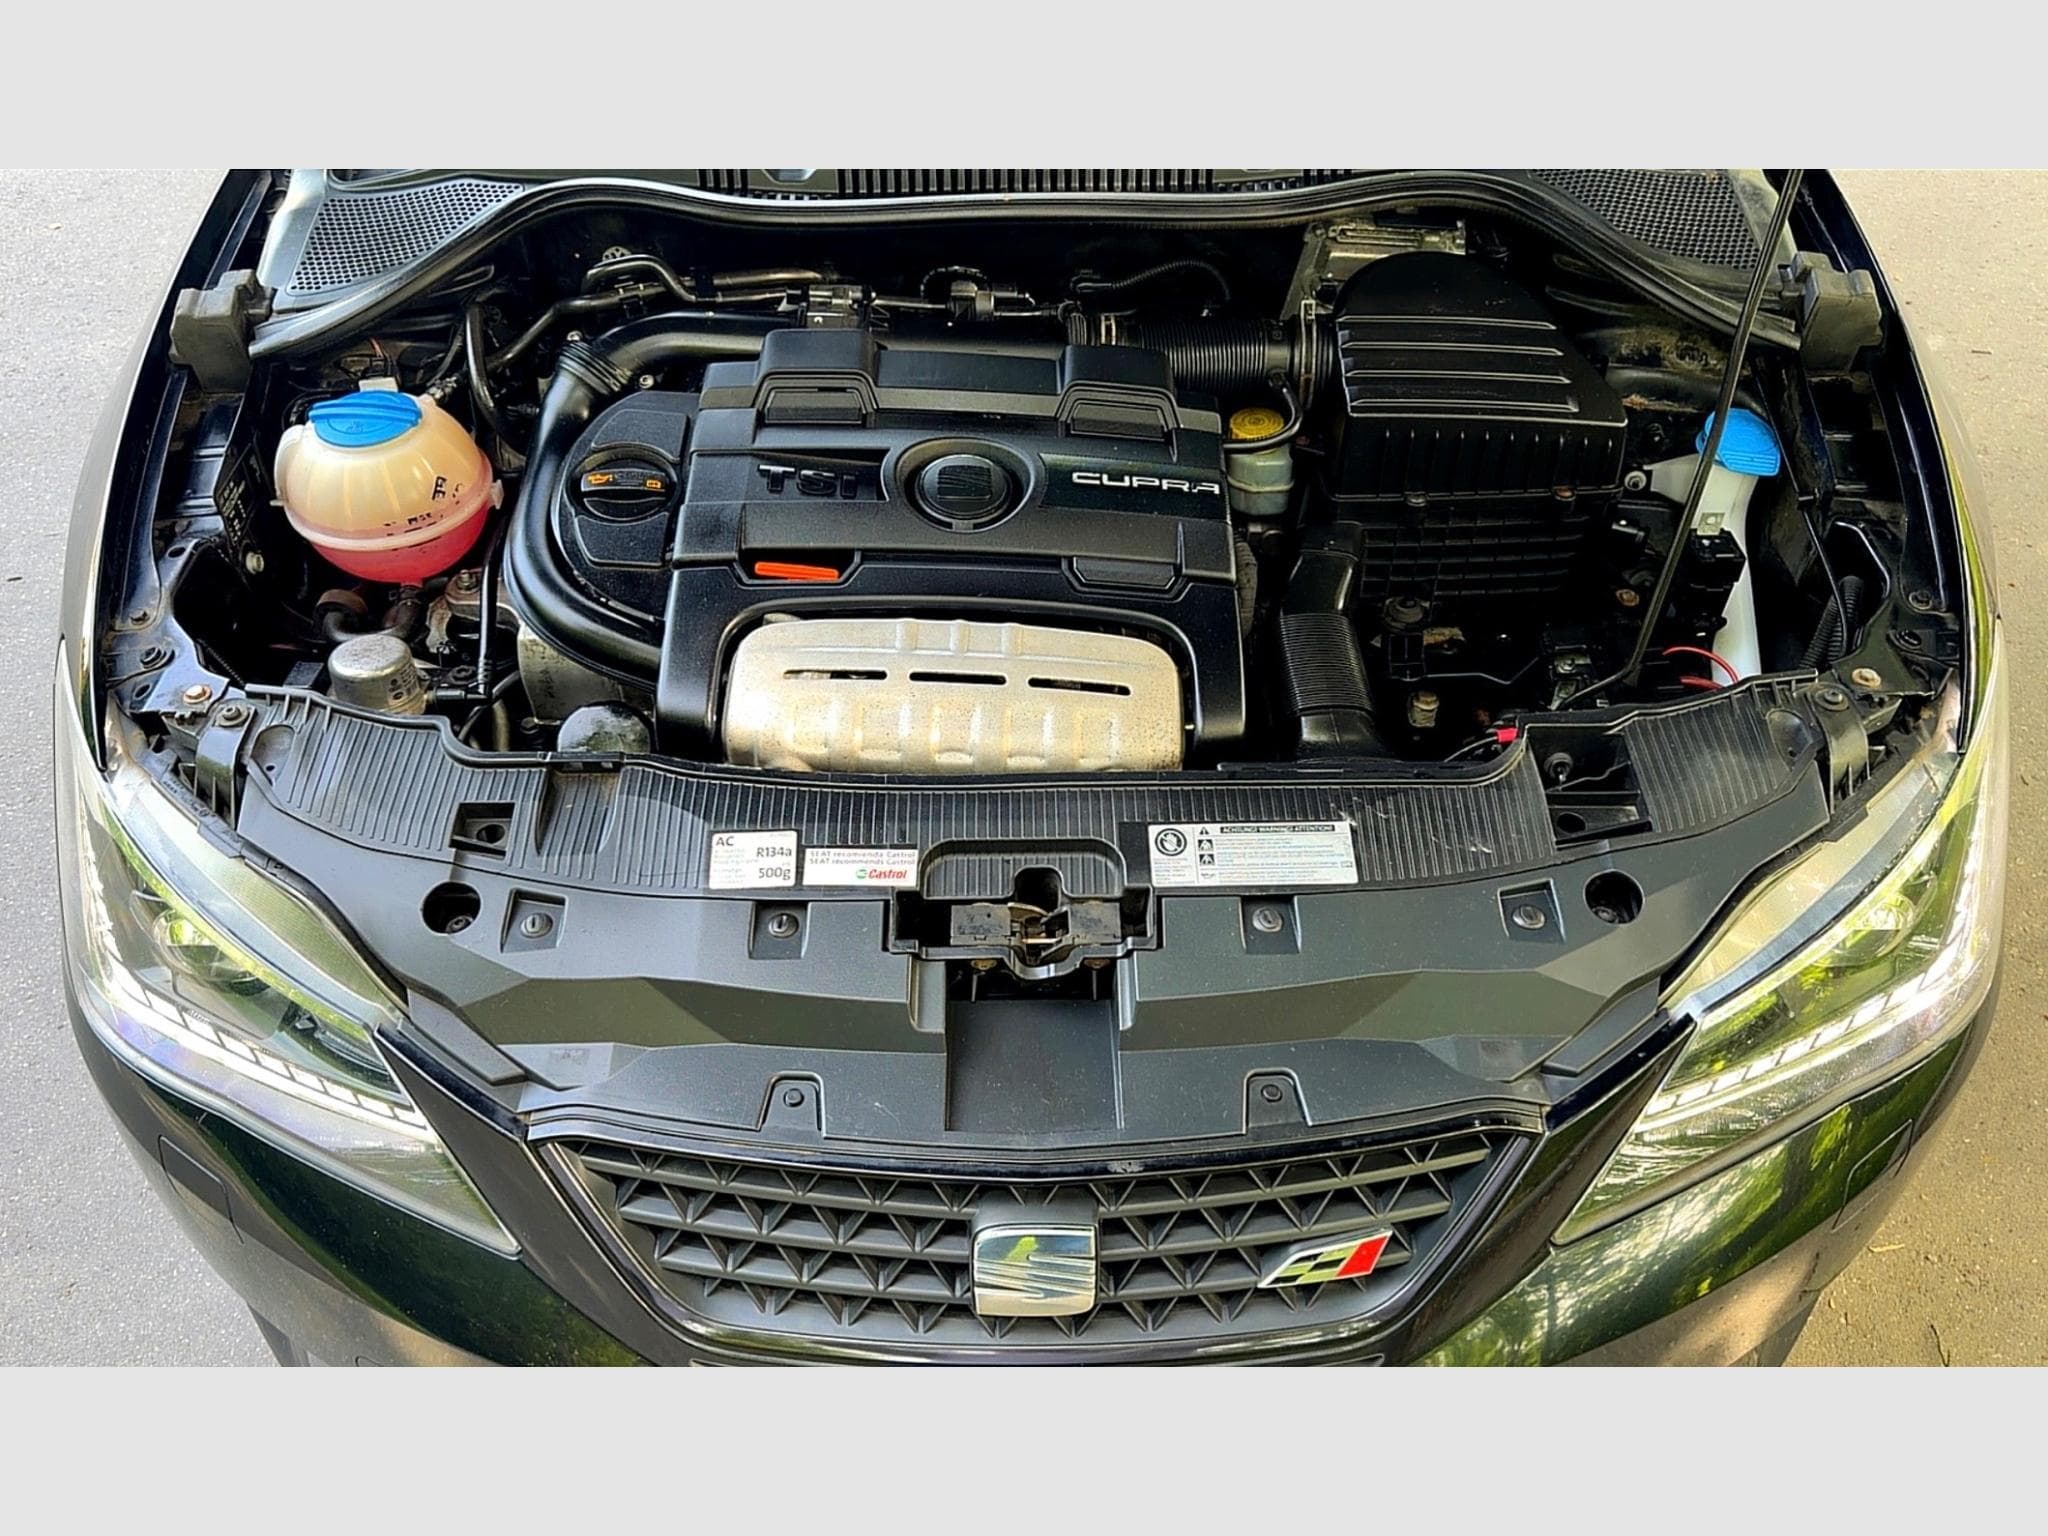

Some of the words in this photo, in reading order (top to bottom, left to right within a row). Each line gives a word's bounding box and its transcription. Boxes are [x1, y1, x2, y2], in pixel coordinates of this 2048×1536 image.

[757, 464, 857, 500] TSI
[1072, 472, 1220, 494] CUPRA
[716, 836, 734, 847] AC
[756, 846, 792, 858] R134a
[886, 858, 915, 866] Castrol
[758, 867, 791, 881] 500g
[868, 869, 908, 879] Castrol
